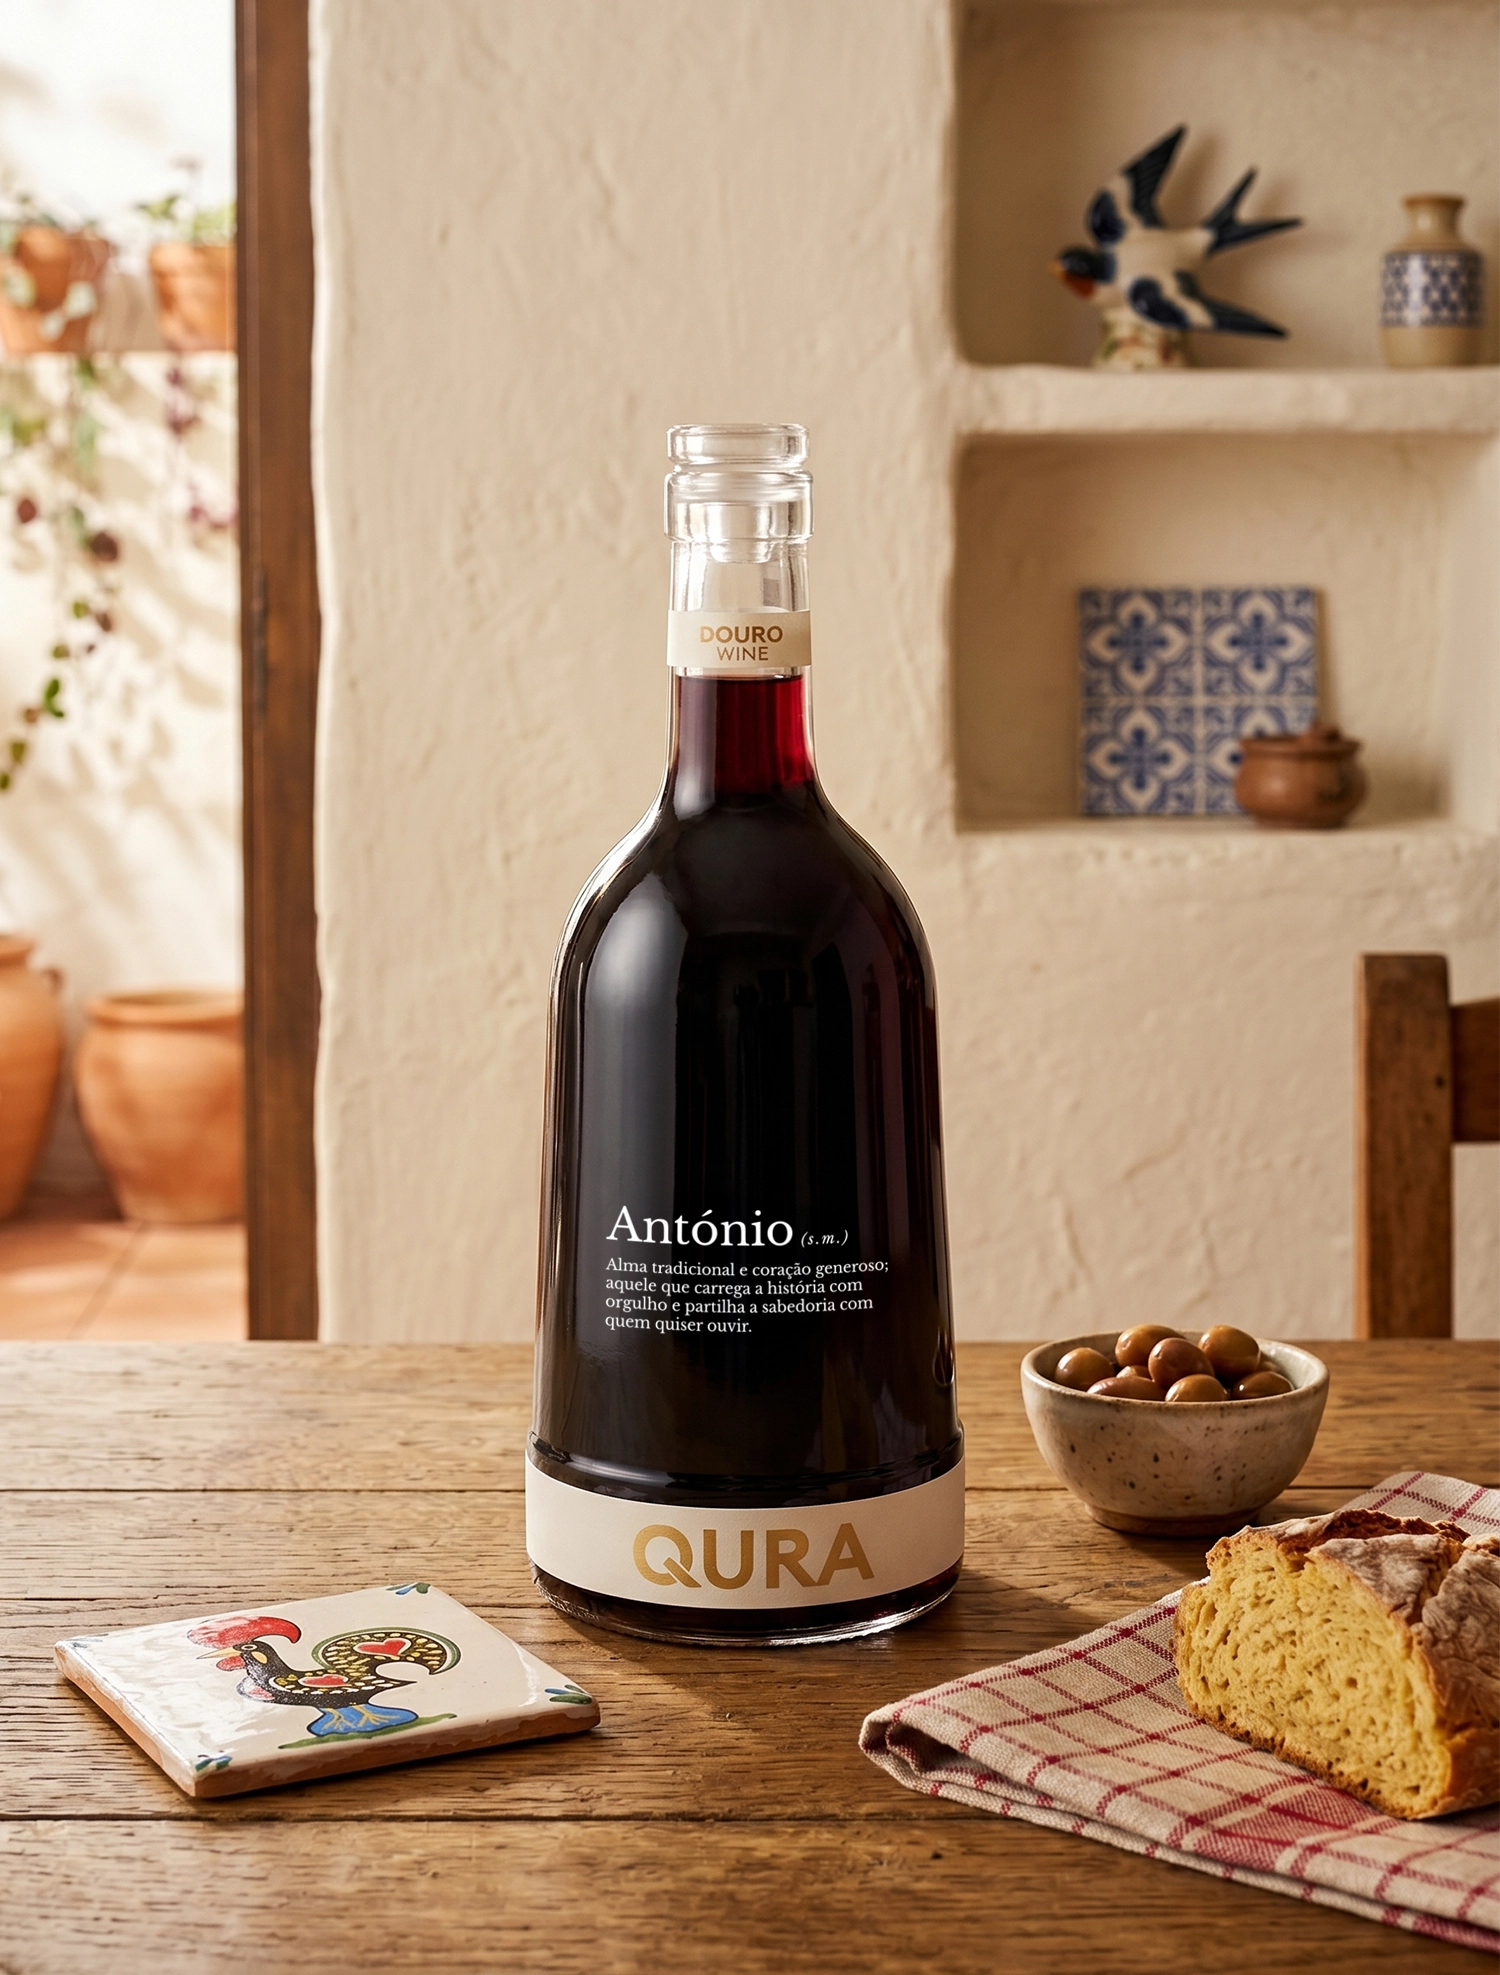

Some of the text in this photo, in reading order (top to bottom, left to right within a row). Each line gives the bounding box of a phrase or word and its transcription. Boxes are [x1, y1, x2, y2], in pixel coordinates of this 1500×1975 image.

[700, 625, 783, 643] DOURO
[717, 646, 769, 661] WINE
[606, 1205, 849, 1248] António (s.m.)
[606, 1257, 889, 1280] Alma tradicional e coração generoso;
[605, 1277, 863, 1298] aquele que carrega a história com
[605, 1296, 873, 1316] orgulho e partilha a sabedoria com
[605, 1315, 752, 1334] quem quiser ouvir.
[632, 1522, 875, 1590] QURA
